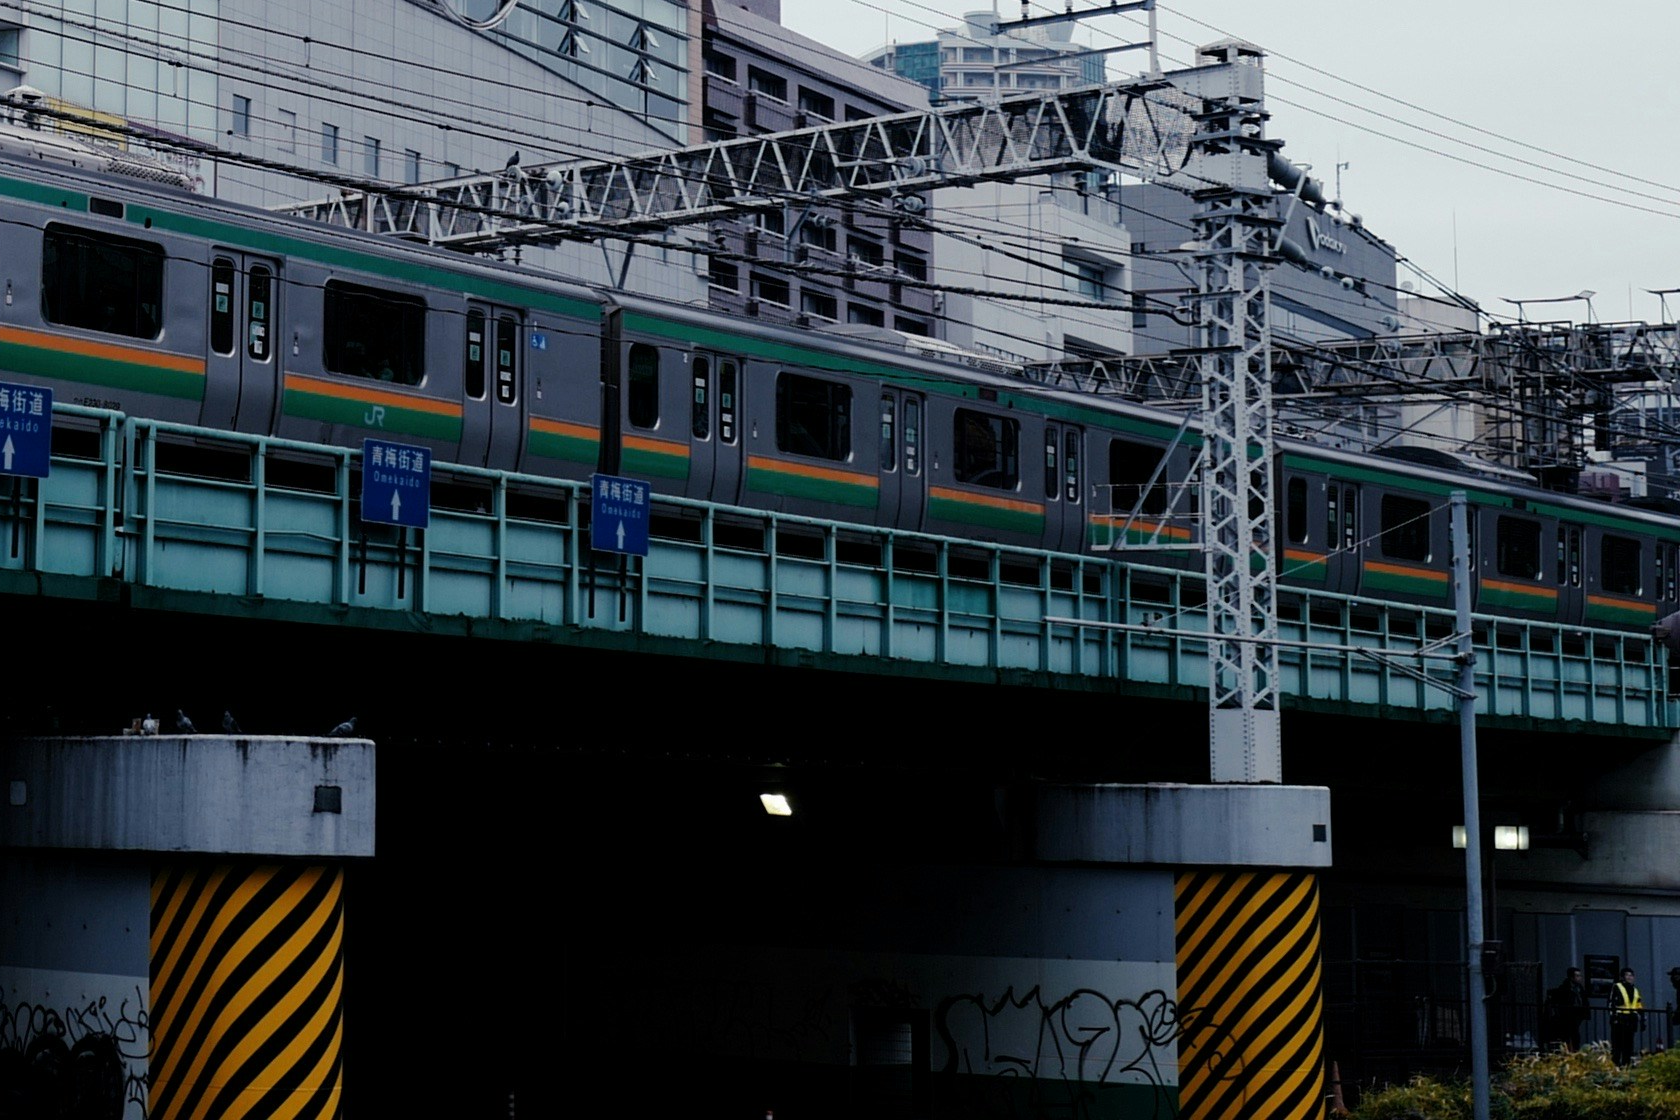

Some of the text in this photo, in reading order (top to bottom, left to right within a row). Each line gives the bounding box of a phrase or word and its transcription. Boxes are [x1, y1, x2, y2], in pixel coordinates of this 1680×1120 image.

[364, 405, 386, 428] JR
[371, 445, 425, 473] 青梅街道
[373, 469, 421, 488] Omekaido
[598, 478, 645, 506] 青梅街道
